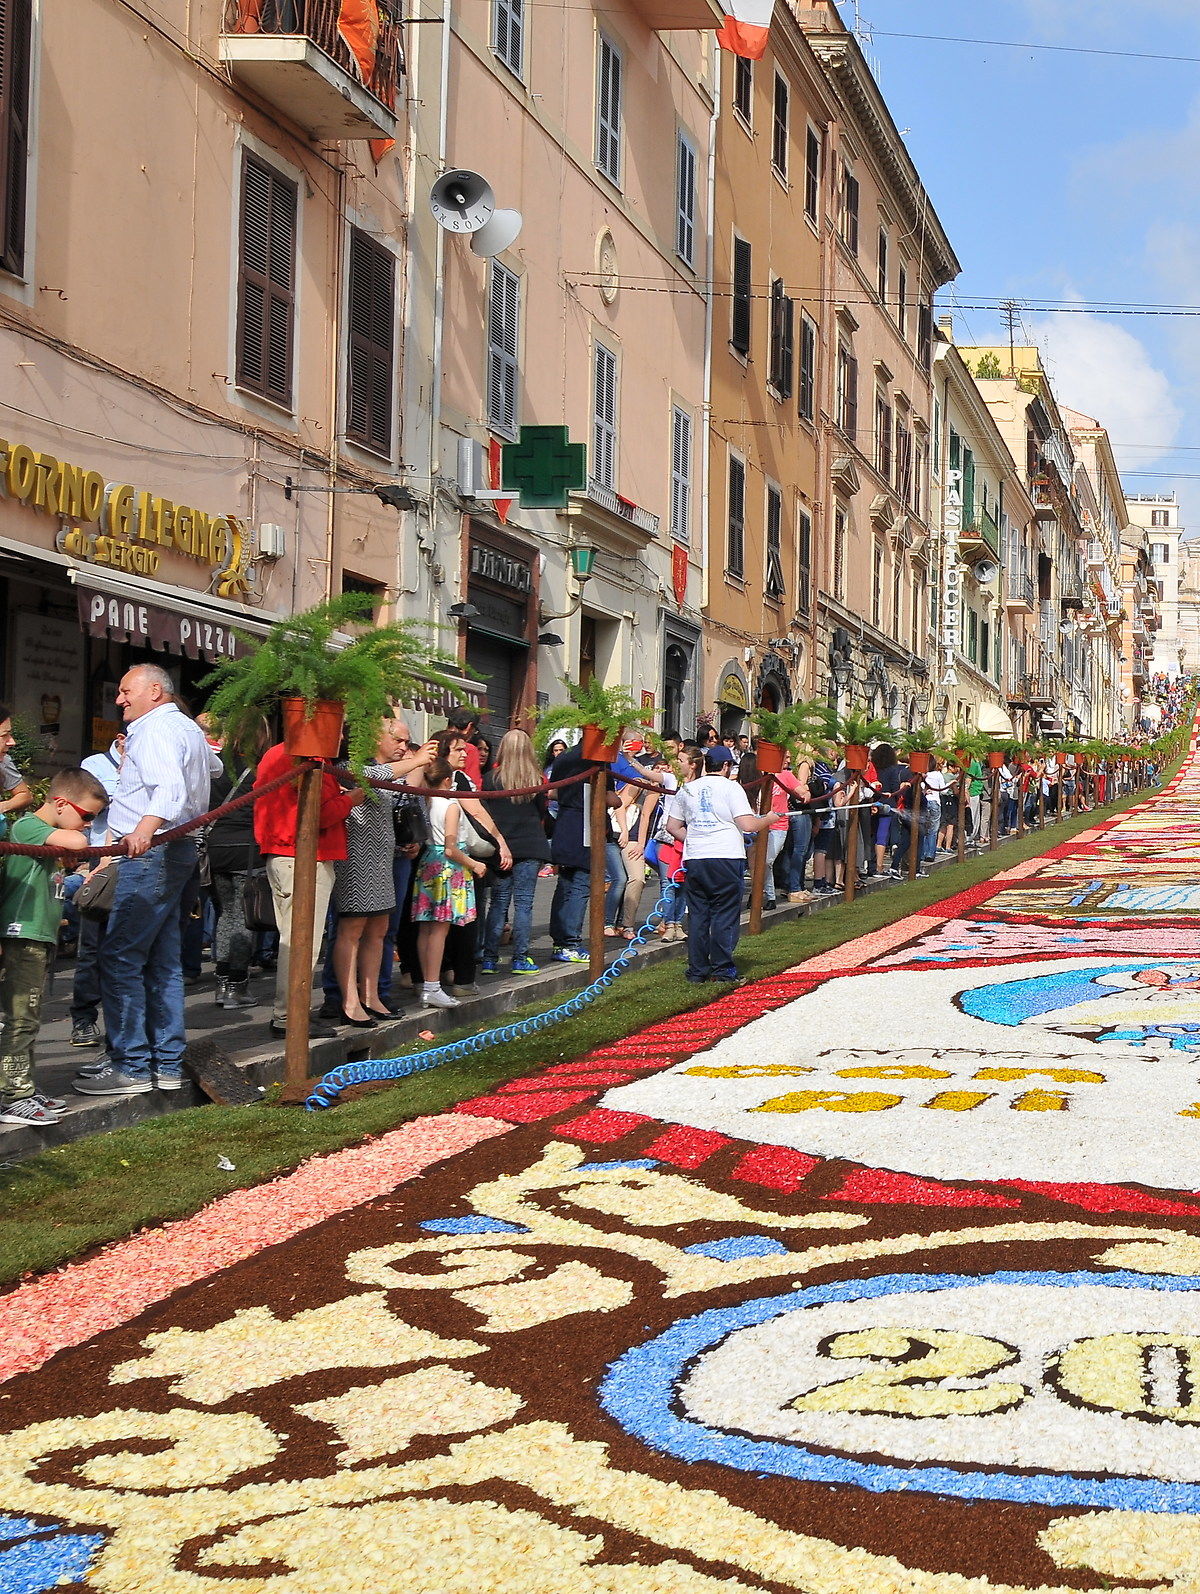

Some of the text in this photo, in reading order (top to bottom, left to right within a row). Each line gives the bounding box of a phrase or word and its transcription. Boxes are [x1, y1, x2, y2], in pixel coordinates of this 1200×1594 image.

[109, 484, 136, 537] A
[93, 535, 160, 576] SERGIO
[941, 469, 963, 685] PASTICCERIA
[90, 594, 237, 657] PANE PIZZA
